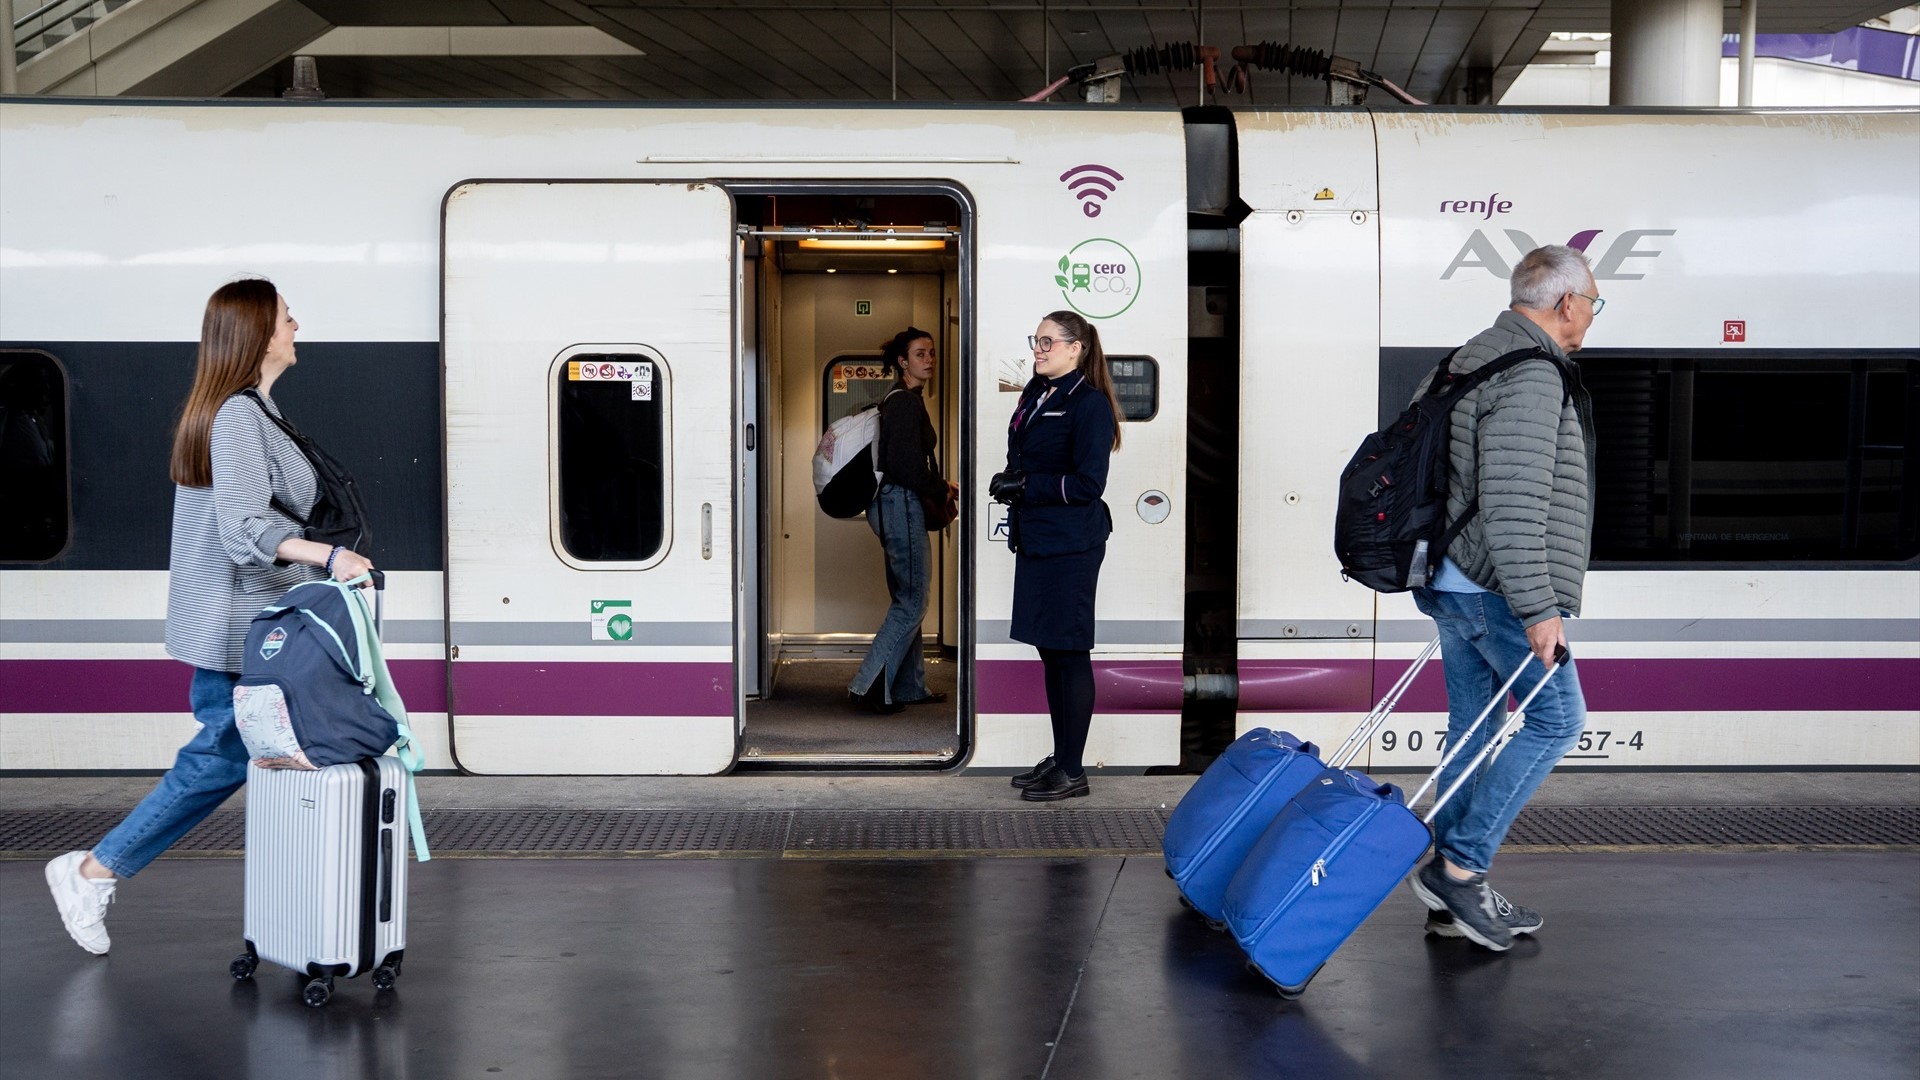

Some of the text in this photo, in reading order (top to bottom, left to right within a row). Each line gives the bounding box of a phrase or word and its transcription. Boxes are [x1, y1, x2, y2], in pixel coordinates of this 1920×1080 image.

[1439, 192, 1513, 221] renfe
[1093, 263, 1126, 275] cero
[1679, 533, 1790, 541] VENTANA DE EMERGENCIA
